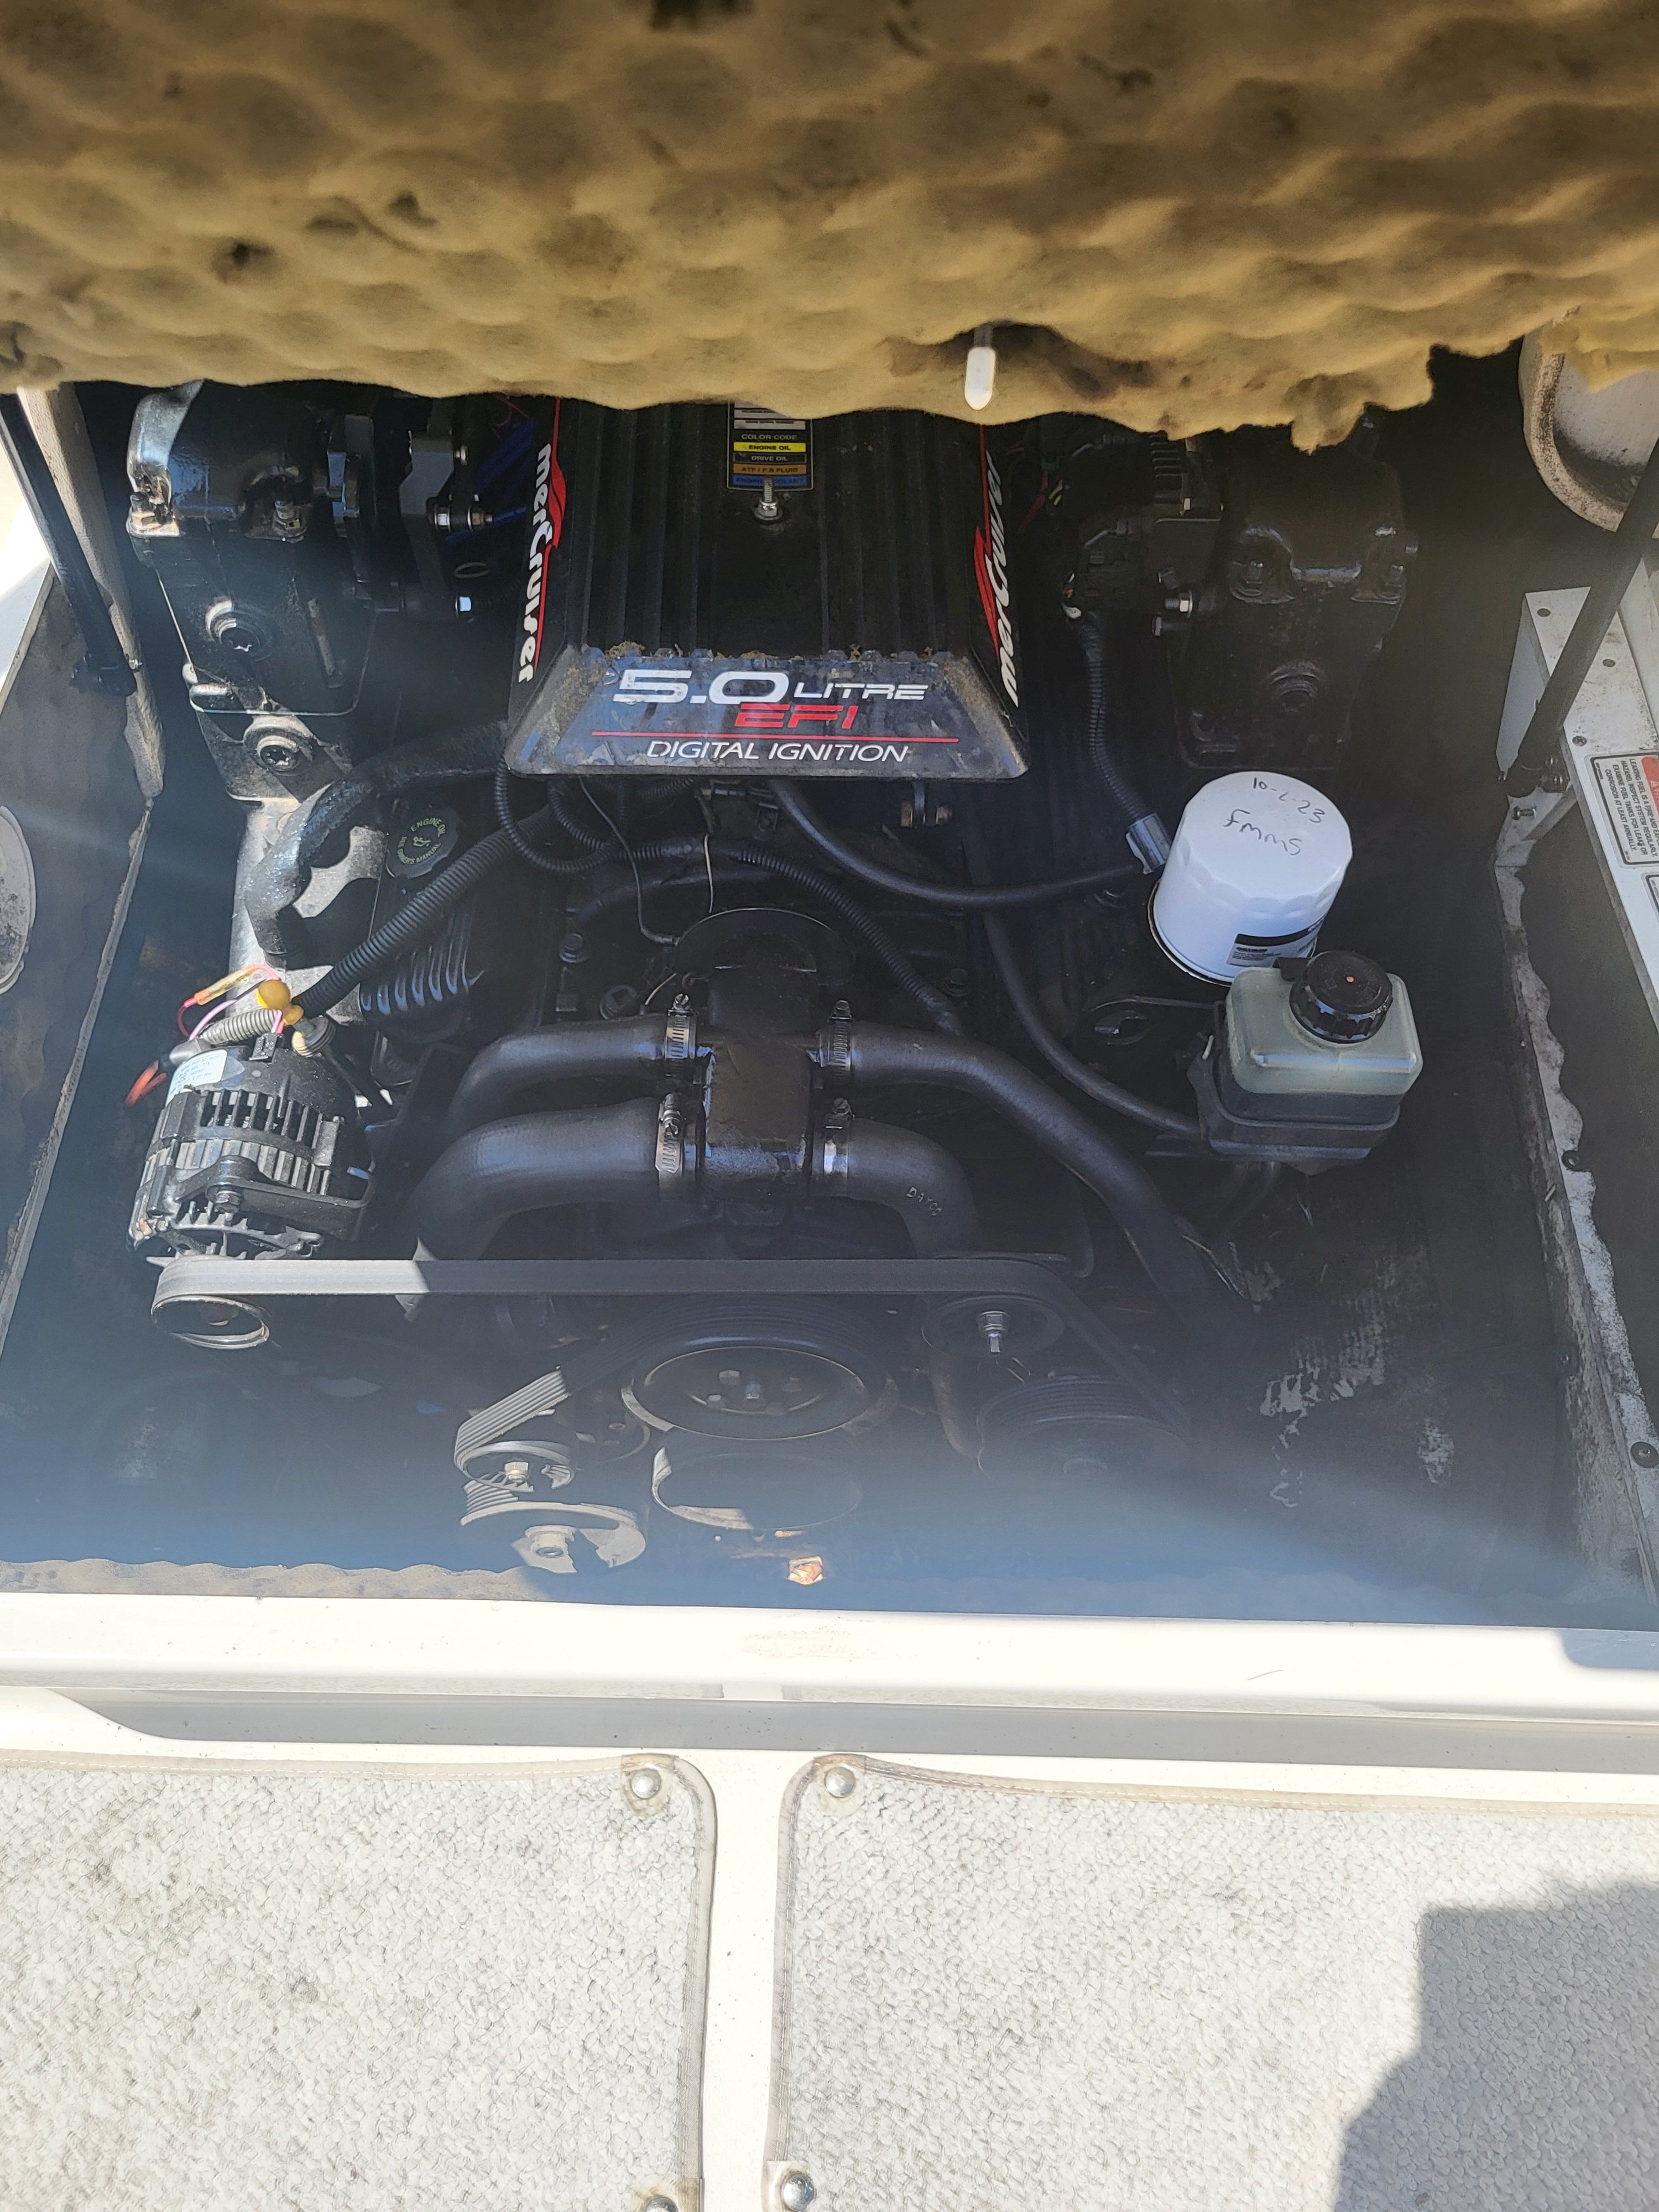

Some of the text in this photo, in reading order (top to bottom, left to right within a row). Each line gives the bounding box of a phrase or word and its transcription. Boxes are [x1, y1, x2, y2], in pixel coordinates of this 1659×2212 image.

[612, 669, 929, 705] 5.0 LITRE
[734, 703, 859, 729] EFI
[646, 740, 909, 763] DIGITAL IGNITION
[1605, 769, 1619, 799] CORROSION
[1617, 807, 1627, 823] LEAST
[1613, 764, 1625, 786] EXAMINE
[1620, 787, 1629, 800] FUEL
[1625, 800, 1635, 817] TANKS
[1630, 818, 1639, 828] FOR
[1628, 783, 1640, 805] INSPECT
[1635, 805, 1647, 825] SYSTEM
[1629, 759, 1641, 780] LEAKING
[1637, 781, 1645, 794] FUEL
[1649, 818, 1658, 828] AND
[410, 817, 446, 837] ENGINE OIL
[416, 842, 441, 863] MANUAL
